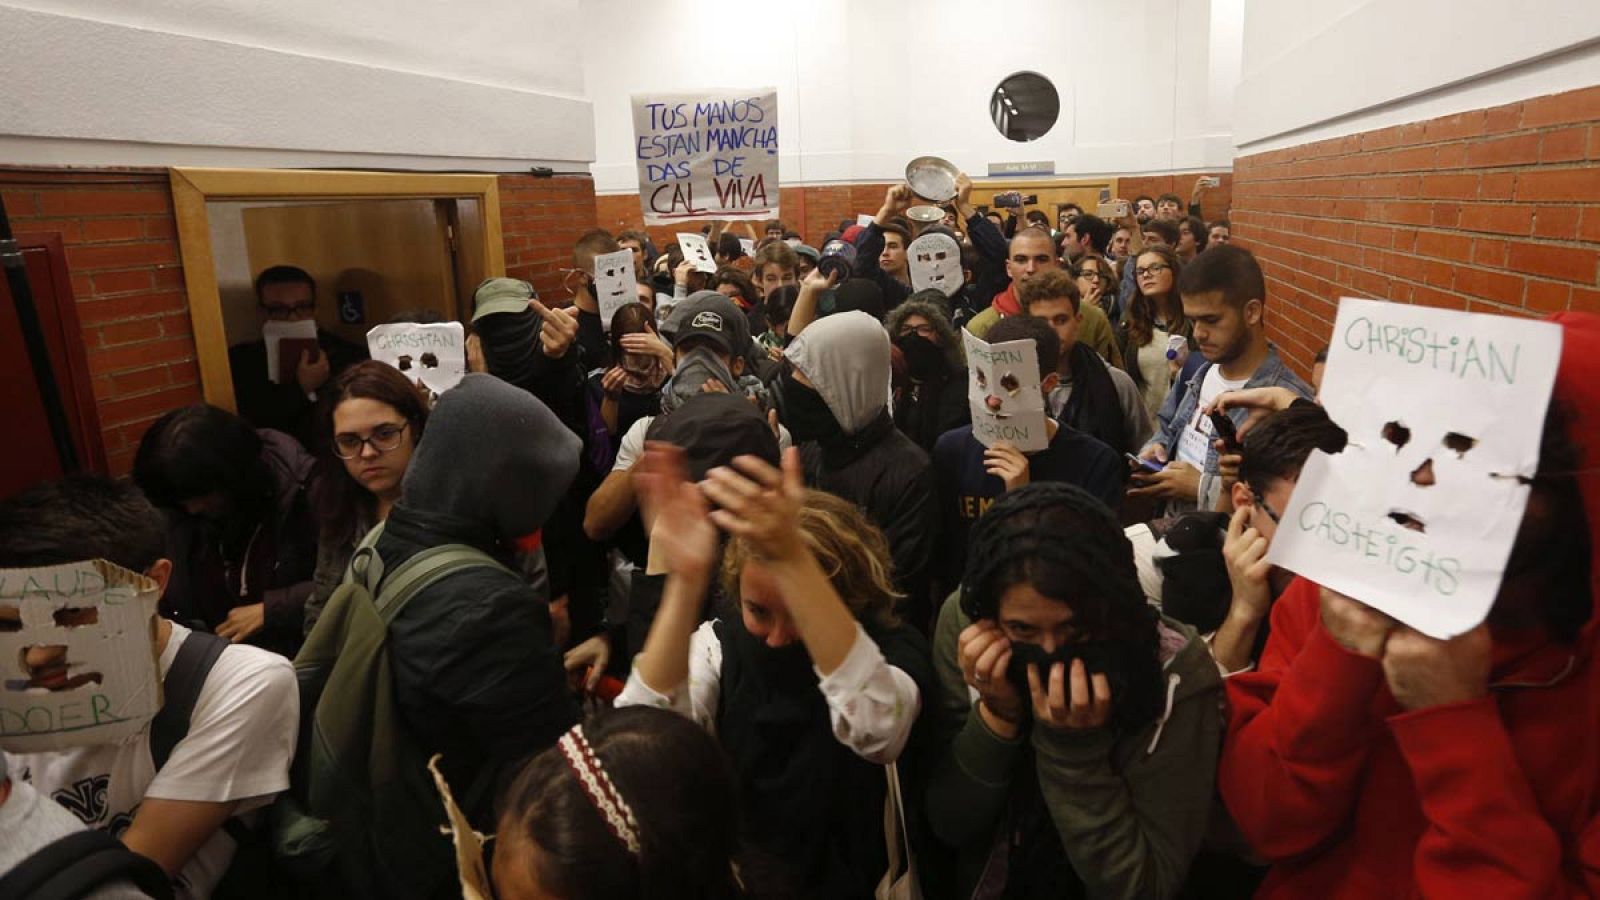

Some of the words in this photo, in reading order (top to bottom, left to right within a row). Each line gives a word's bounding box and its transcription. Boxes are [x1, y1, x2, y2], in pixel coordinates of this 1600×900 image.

[645, 103, 688, 131] TUS
[693, 97, 764, 128] MANOS
[638, 131, 700, 159] ESTAN
[706, 126, 778, 152] MANCHA
[646, 161, 691, 182] DAS
[713, 157, 746, 178] DE
[651, 182, 707, 213] CAL
[713, 173, 768, 209] VIVA
